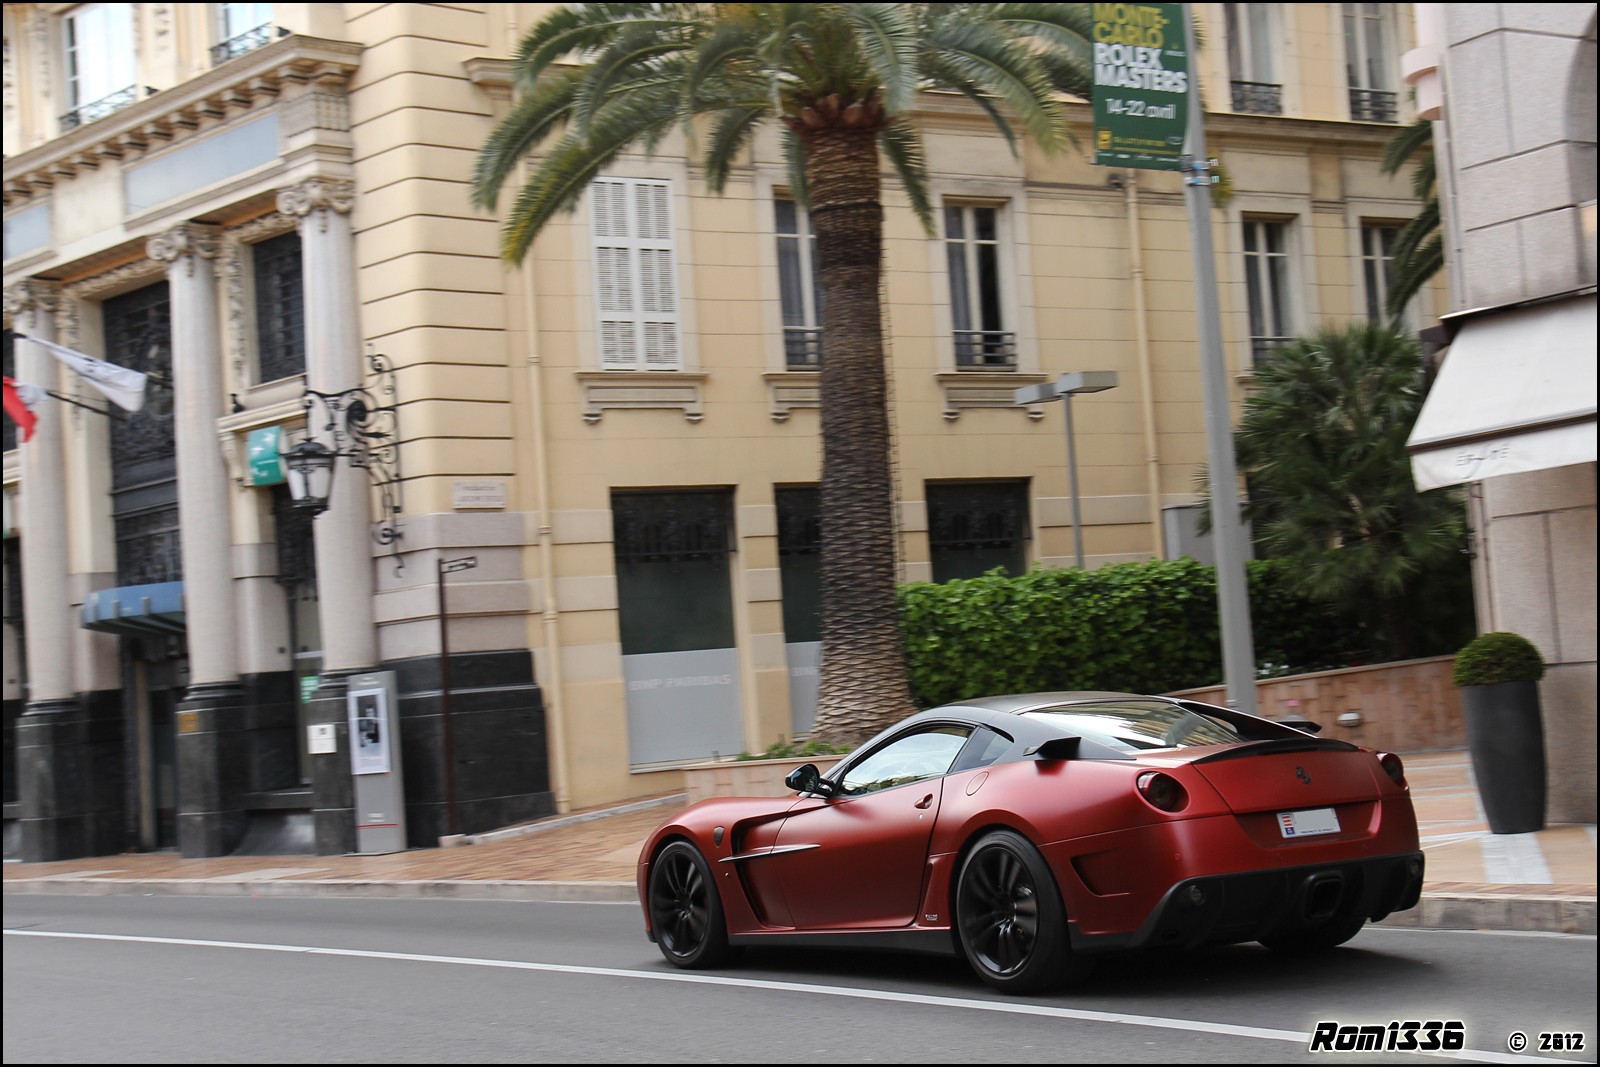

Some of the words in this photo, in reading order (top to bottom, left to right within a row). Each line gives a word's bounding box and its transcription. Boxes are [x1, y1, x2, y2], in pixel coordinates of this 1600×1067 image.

[1093, 22, 1164, 49] CARLO
[1093, 43, 1163, 70] ROLEX
[1094, 64, 1188, 93] MASTERS
[1105, 98, 1146, 117] 14-22
[1146, 104, 1176, 119] avril
